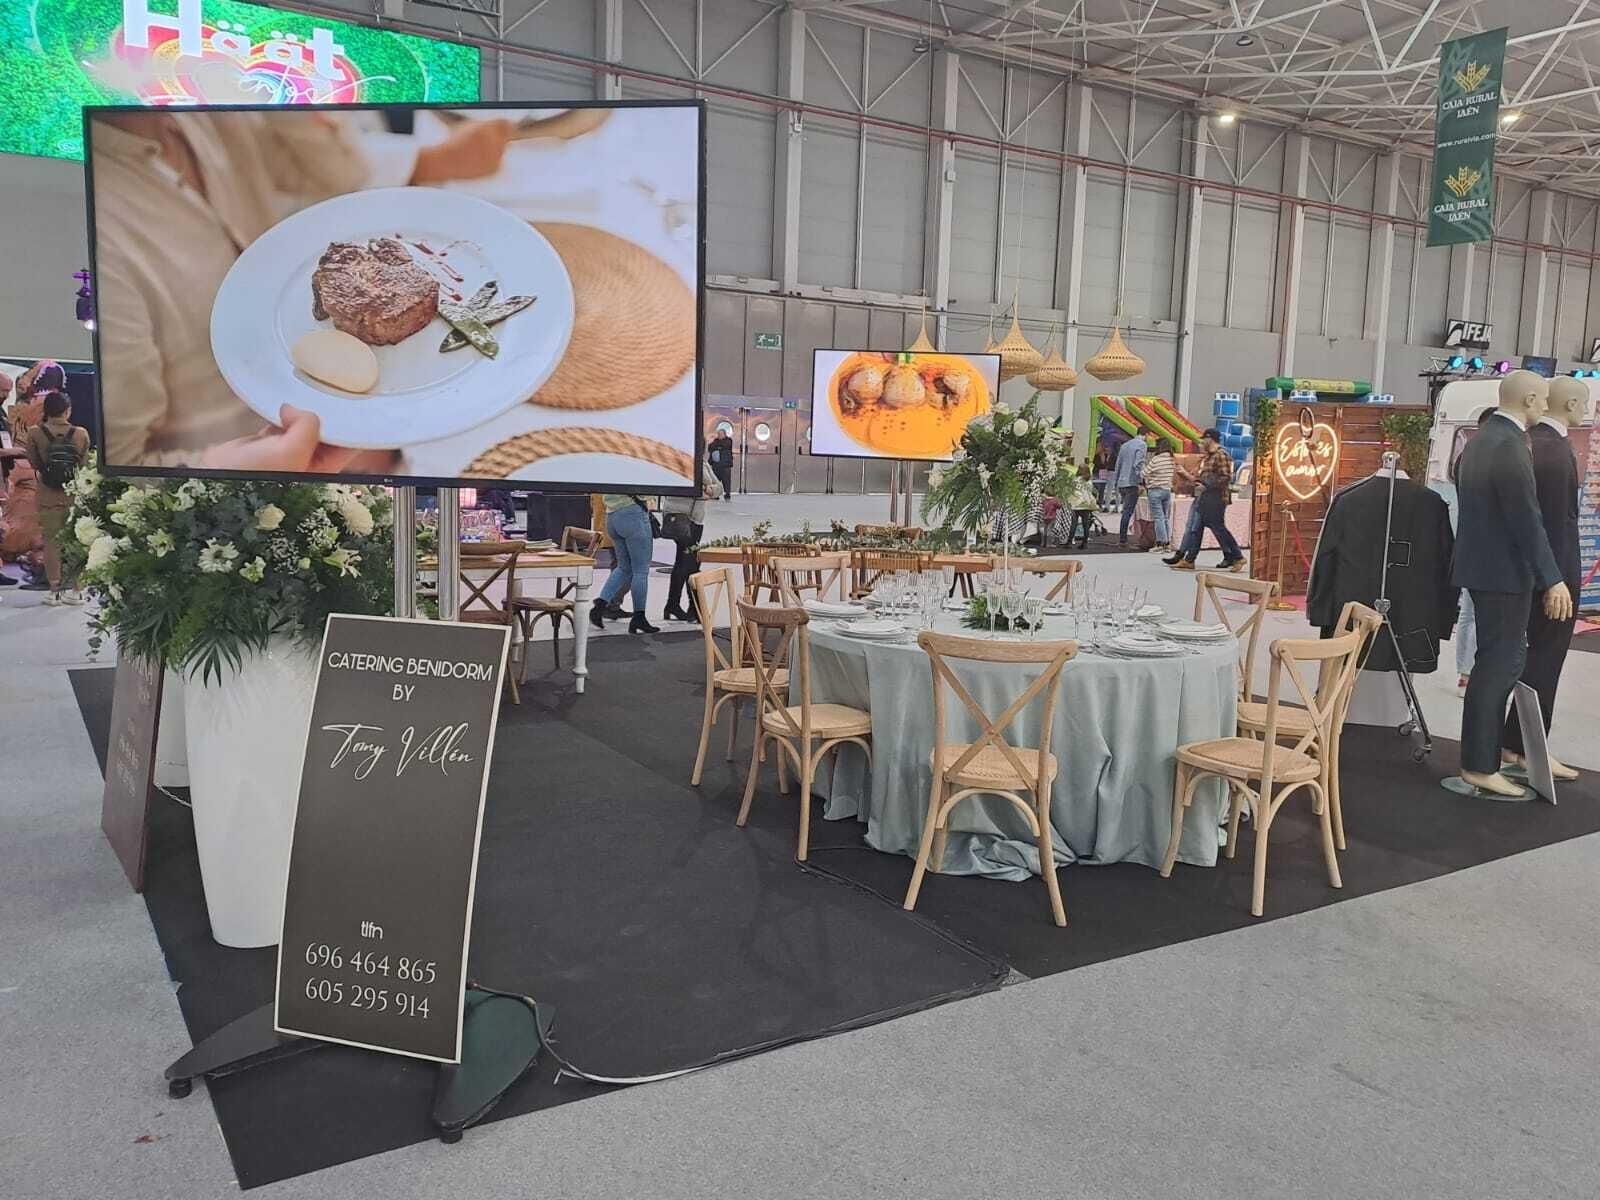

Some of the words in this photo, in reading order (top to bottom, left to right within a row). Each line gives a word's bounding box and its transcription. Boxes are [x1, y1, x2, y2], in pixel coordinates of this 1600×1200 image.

[1465, 91, 1498, 105] RURAL
[1457, 198, 1488, 210] RURAL
[328, 651, 404, 674] CATERING
[406, 658, 493, 681] BENIDORM
[392, 683, 416, 702] BY
[396, 722, 474, 777] Villén
[360, 920, 384, 940] tlfn
[305, 942, 343, 969] 696
[350, 950, 390, 977] 464
[397, 957, 437, 985] 865
[305, 977, 344, 1004] 605
[350, 984, 389, 1012] 295
[395, 992, 430, 1019] 914
